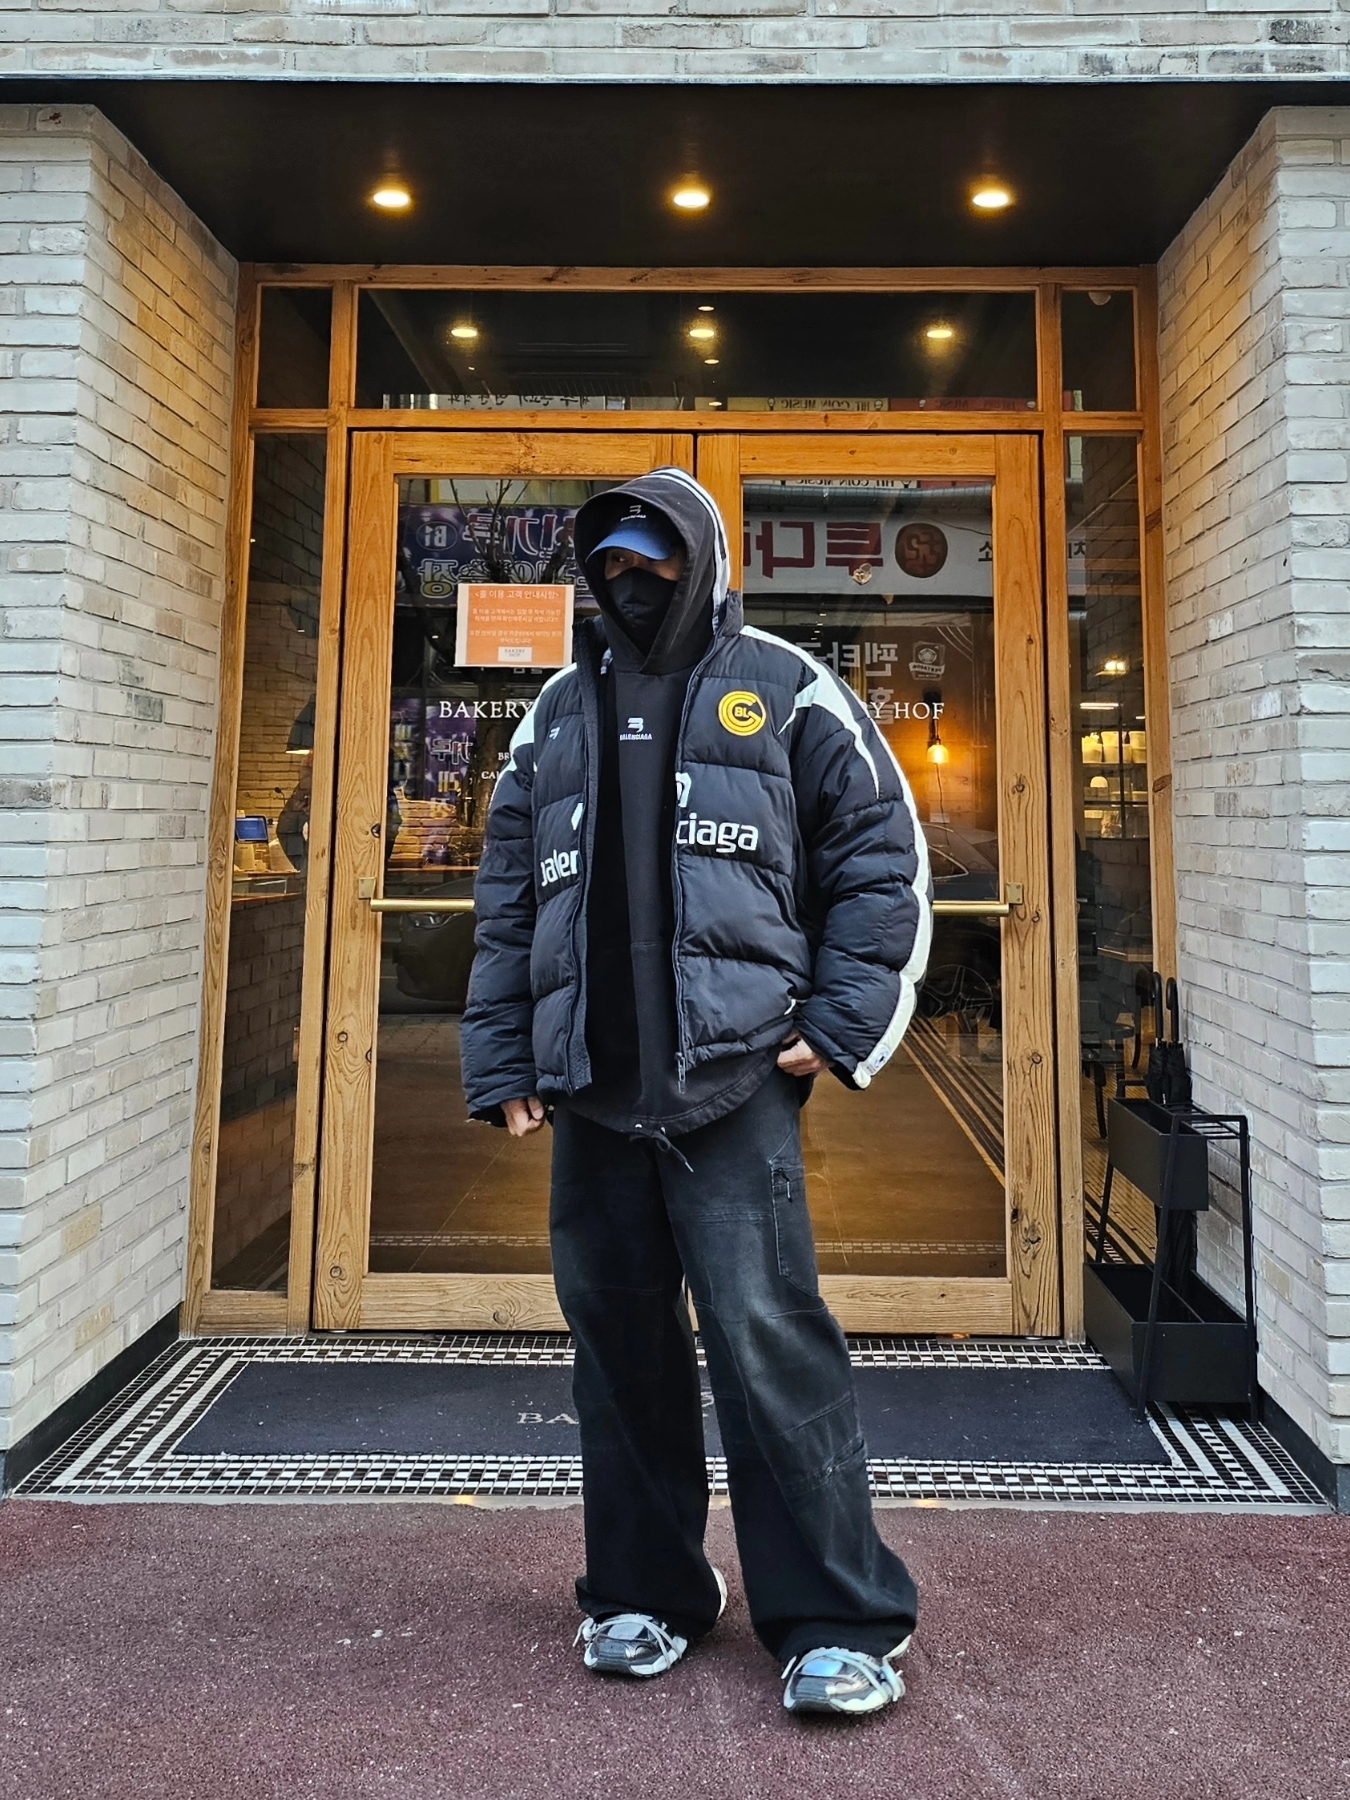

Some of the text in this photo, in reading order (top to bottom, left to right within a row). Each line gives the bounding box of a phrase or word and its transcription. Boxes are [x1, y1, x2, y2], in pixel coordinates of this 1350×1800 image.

[439, 701, 533, 718] BAKERY
[893, 701, 945, 720] HOF
[676, 812, 759, 853] ciaga
